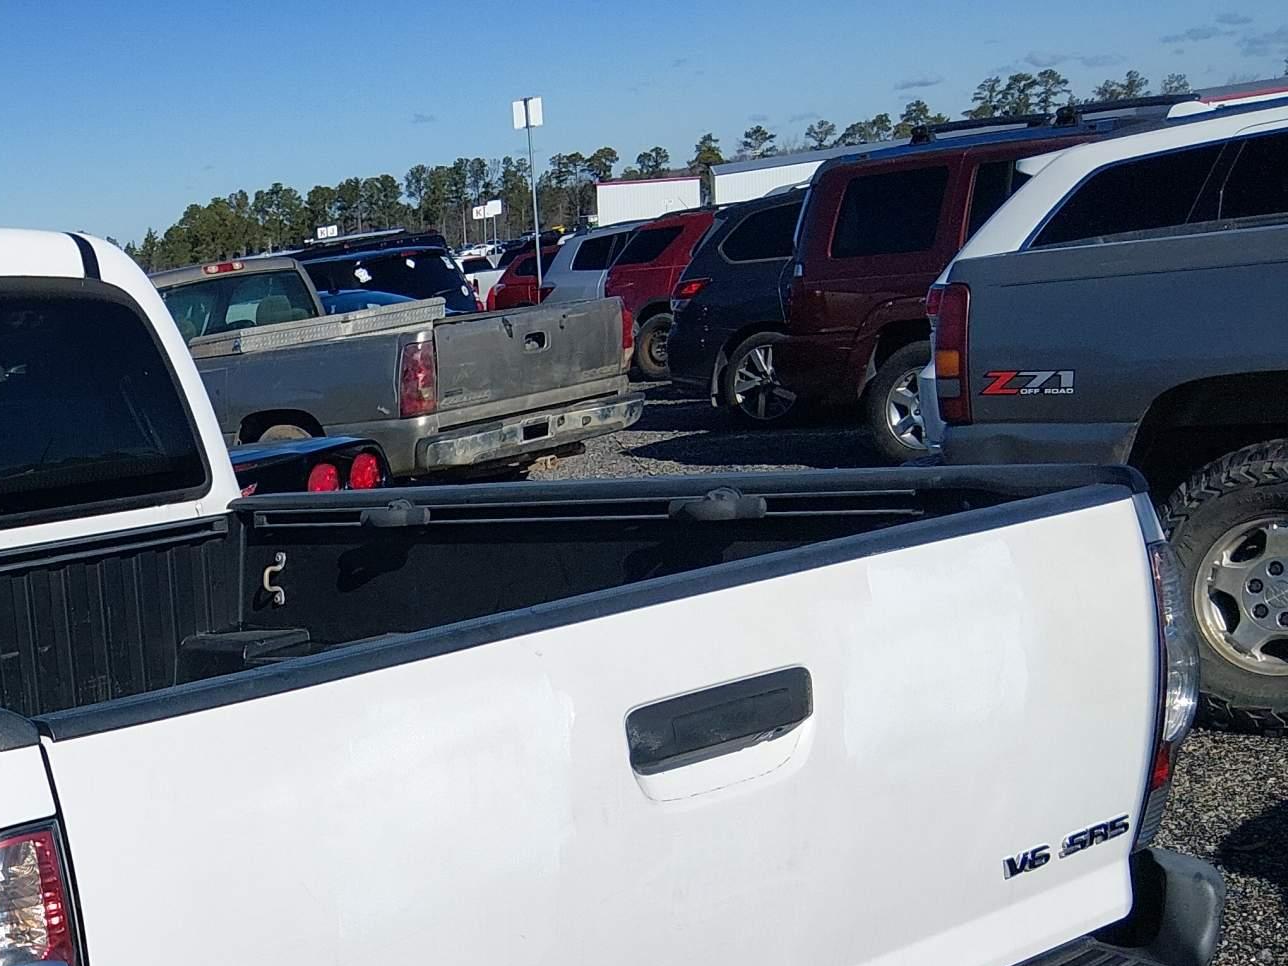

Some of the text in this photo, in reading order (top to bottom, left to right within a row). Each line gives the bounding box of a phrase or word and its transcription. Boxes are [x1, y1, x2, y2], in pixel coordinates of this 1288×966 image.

[980, 369, 1075, 396] Z71
[1044, 387, 1075, 395] ROAD
[1002, 844, 1051, 880] V6
